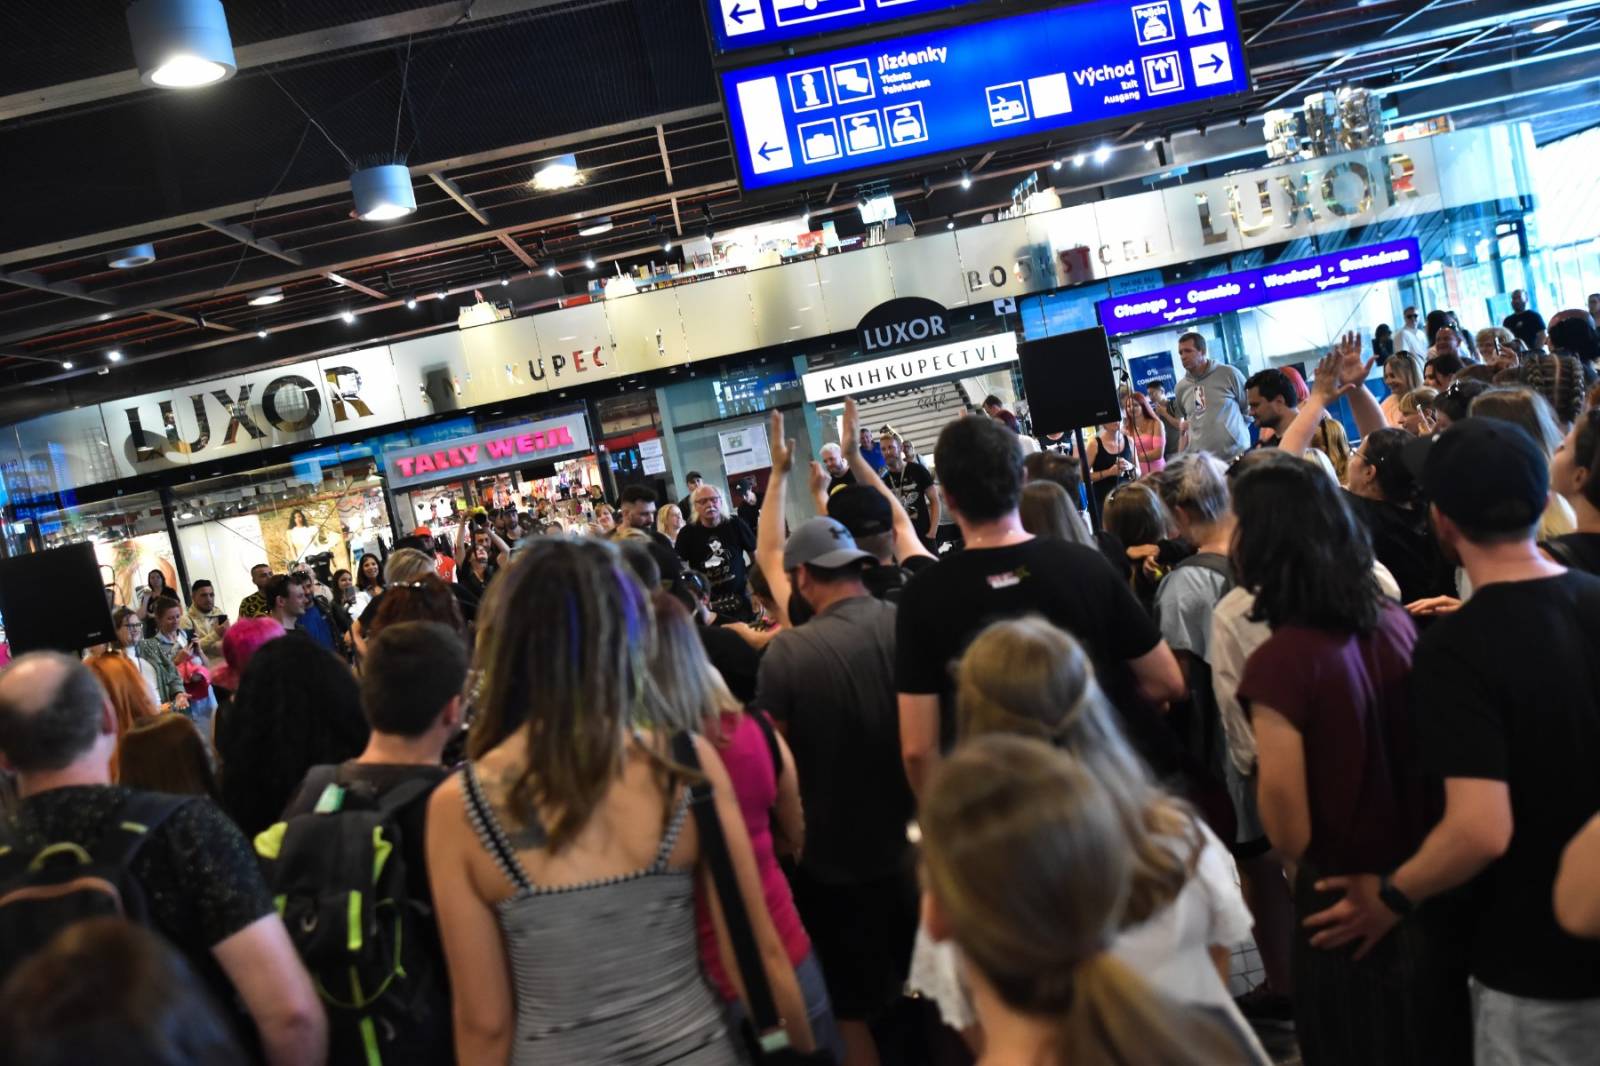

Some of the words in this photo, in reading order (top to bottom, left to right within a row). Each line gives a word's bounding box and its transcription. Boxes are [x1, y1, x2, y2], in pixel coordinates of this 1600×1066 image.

[1073, 59, 1135, 87] Východ
[1104, 91, 1140, 105] Ausgang
[1195, 153, 1419, 246] LUXOR
[1114, 299, 1168, 318] Change
[864, 315, 945, 350] LUXOR
[125, 365, 374, 463] LUXOR
[395, 444, 479, 477] TALLY
